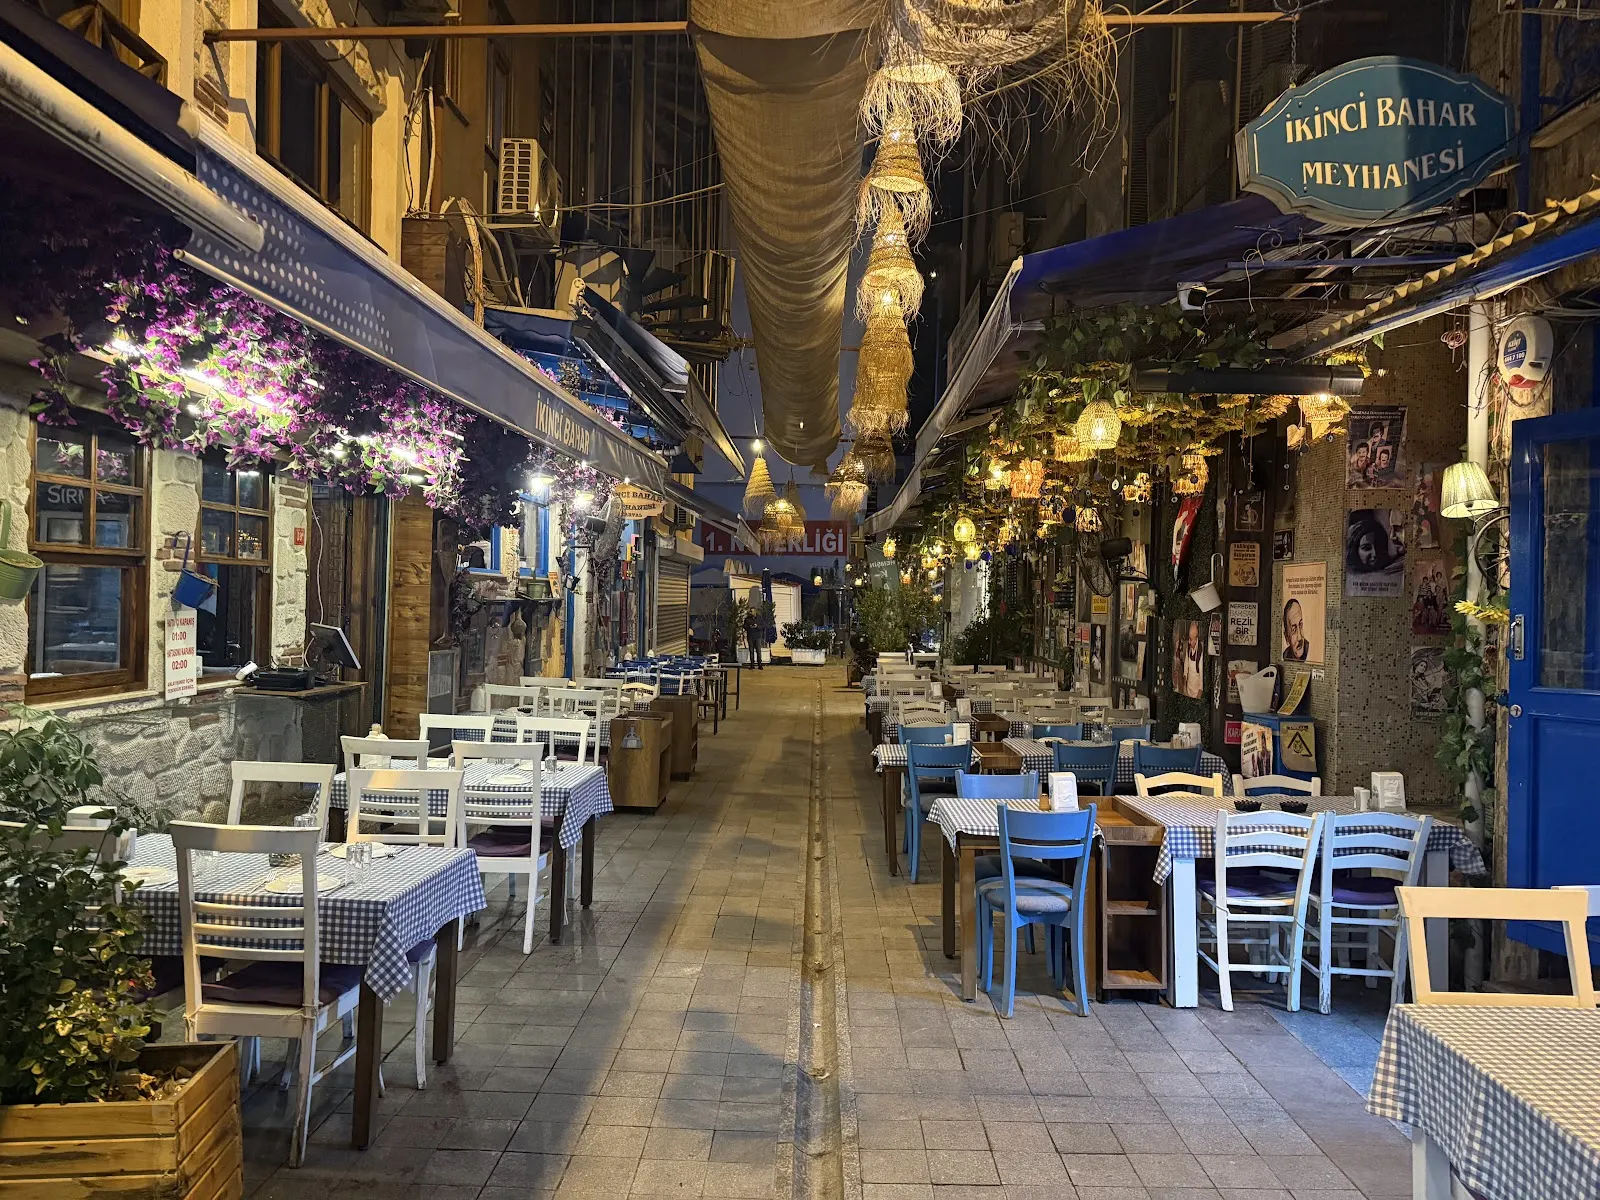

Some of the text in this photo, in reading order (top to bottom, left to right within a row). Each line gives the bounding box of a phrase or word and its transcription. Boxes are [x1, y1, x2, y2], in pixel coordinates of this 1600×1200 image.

[1285, 92, 1477, 143] İKİNCİ BAHAR
[1302, 140, 1465, 190] MEYHANESİ
[536, 392, 590, 455] İKİNCİ BAHAR
[706, 532, 723, 552] 1.
[1230, 617, 1255, 626] REZİL
[171, 631, 187, 641] 01:00
[1236, 626, 1249, 635] BİR
[171, 659, 188, 671] 02:00
